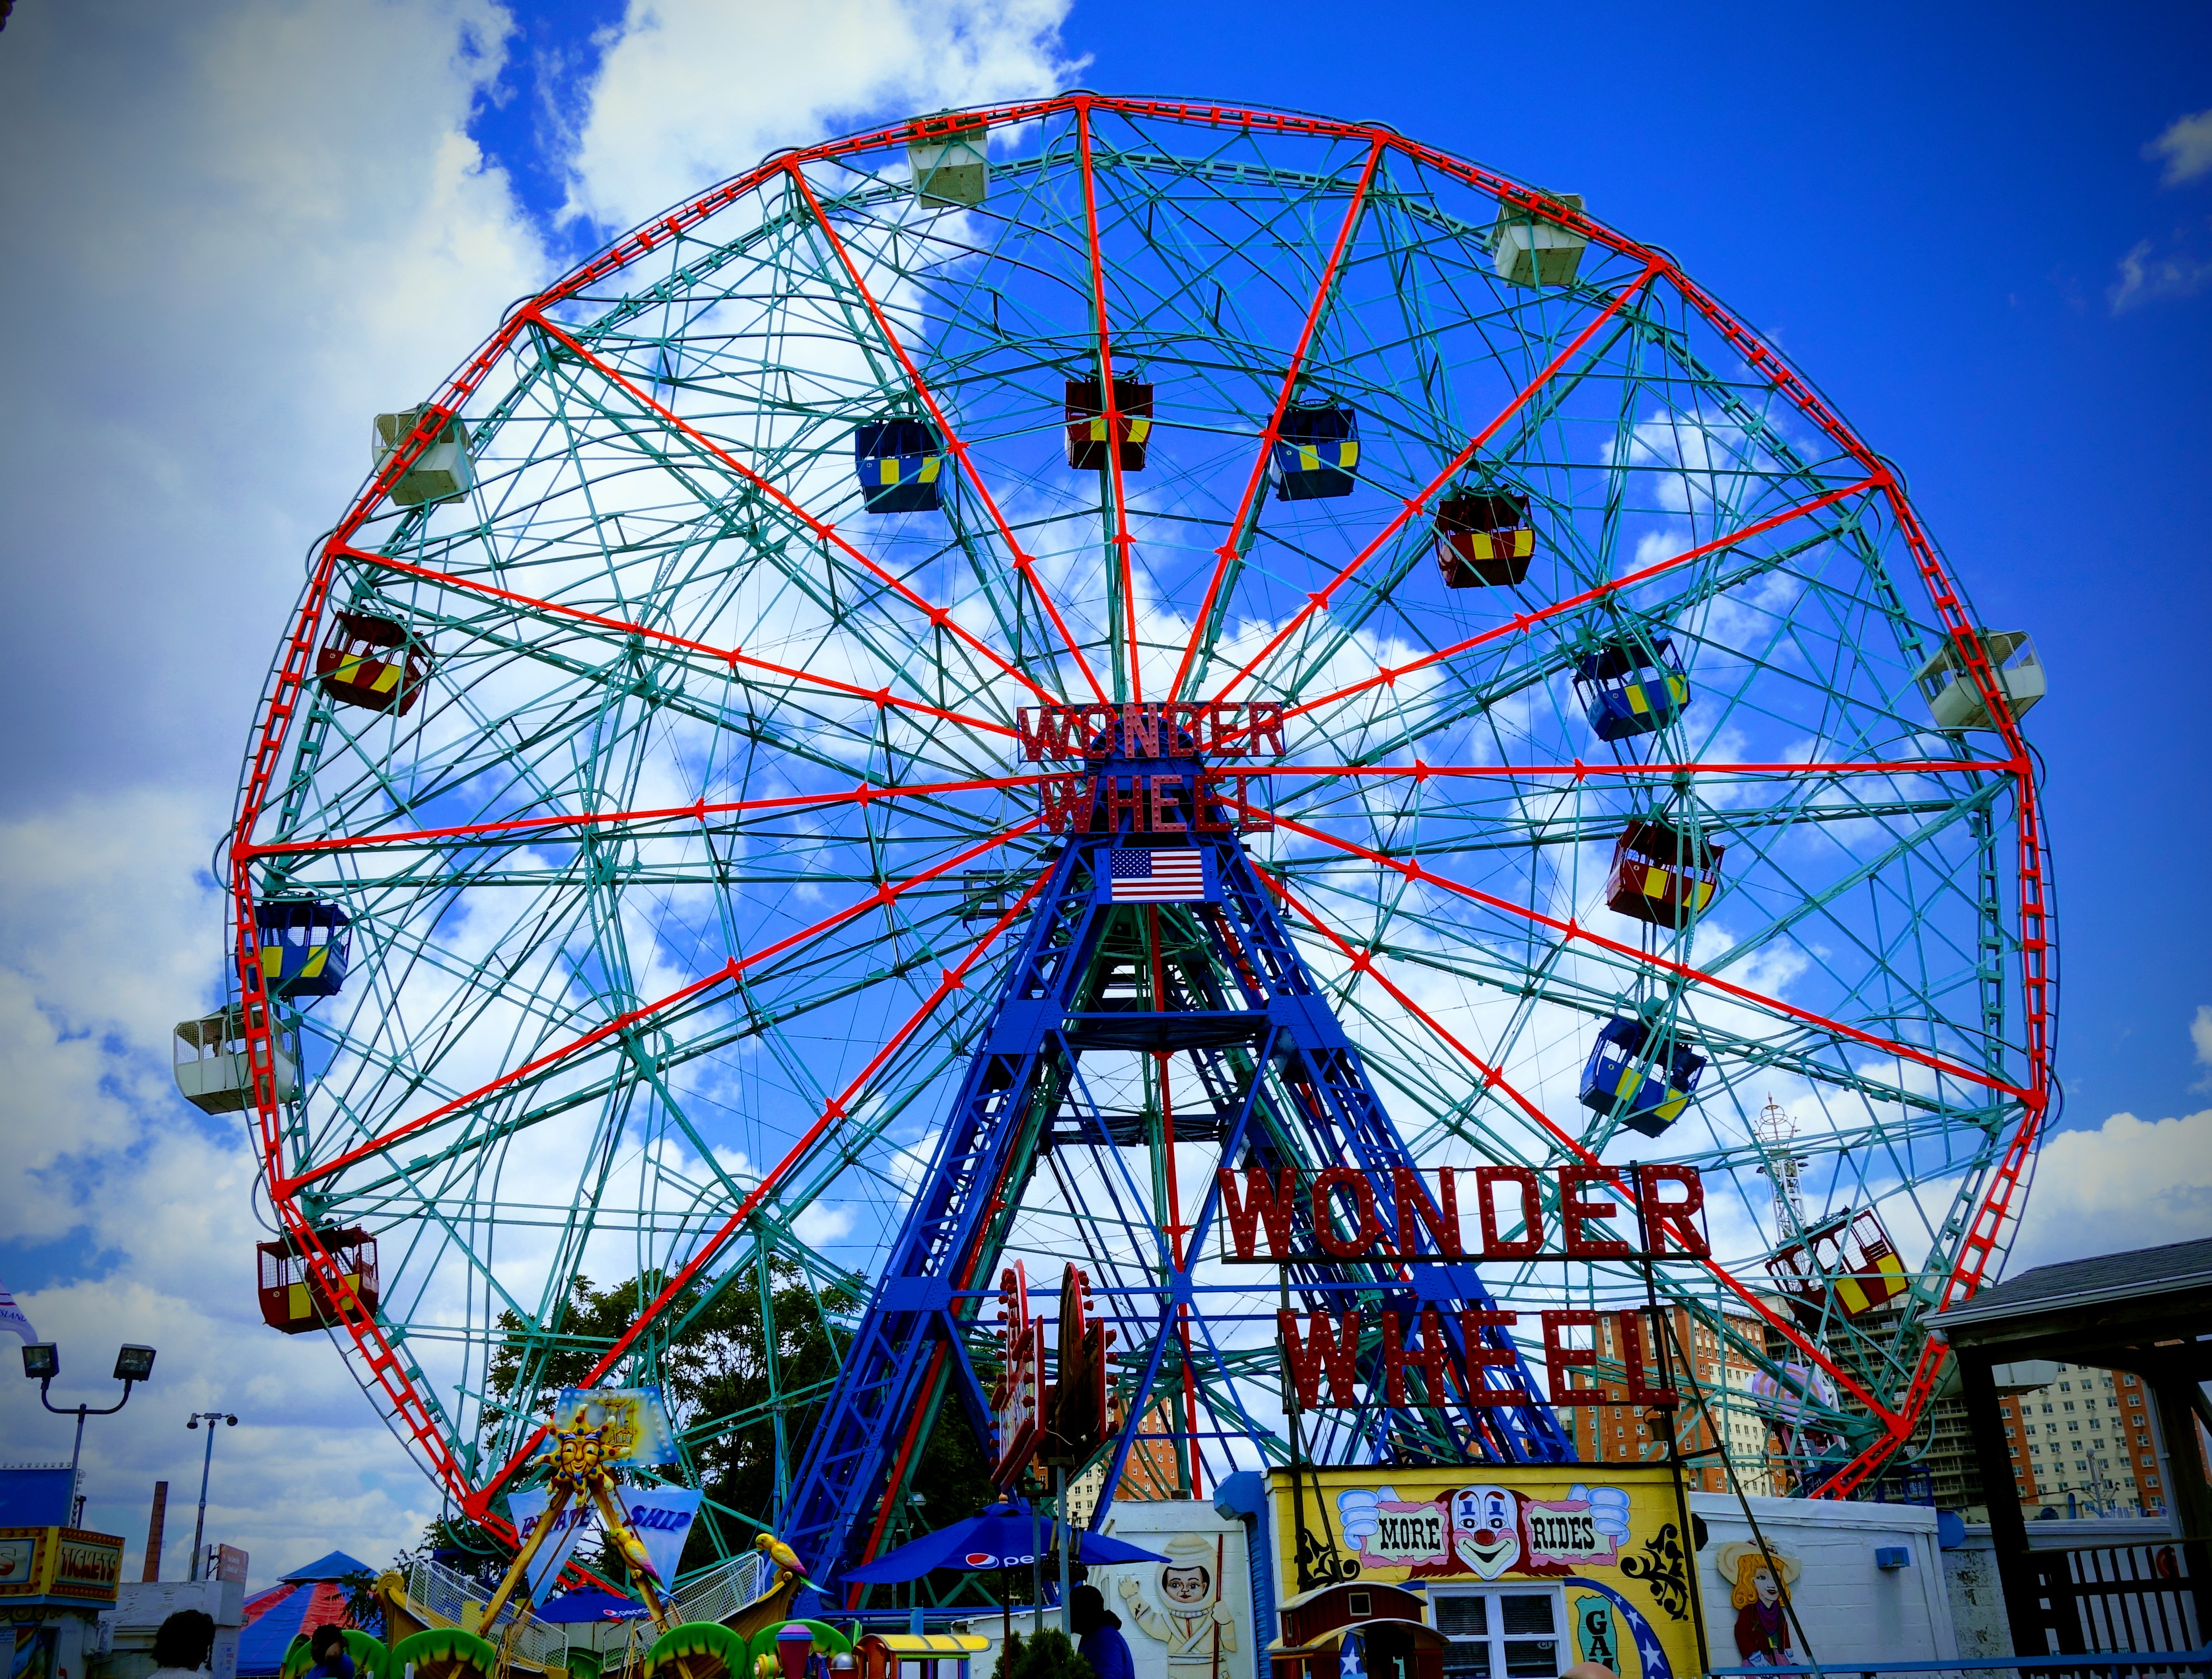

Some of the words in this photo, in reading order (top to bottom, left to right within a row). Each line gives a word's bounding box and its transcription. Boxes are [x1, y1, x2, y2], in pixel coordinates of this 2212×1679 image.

[1017, 702, 1286, 760] WONDER
[1039, 774, 1275, 834] WHEEL
[1218, 1165, 1711, 1258] WONDER
[1279, 1309, 1679, 1409] WHEEL
[631, 1505, 691, 1531] SHIP
[1379, 1518, 1441, 1550] MORE
[1530, 1517, 1596, 1550] RIDES
[61, 1547, 118, 1581] TICKETS
